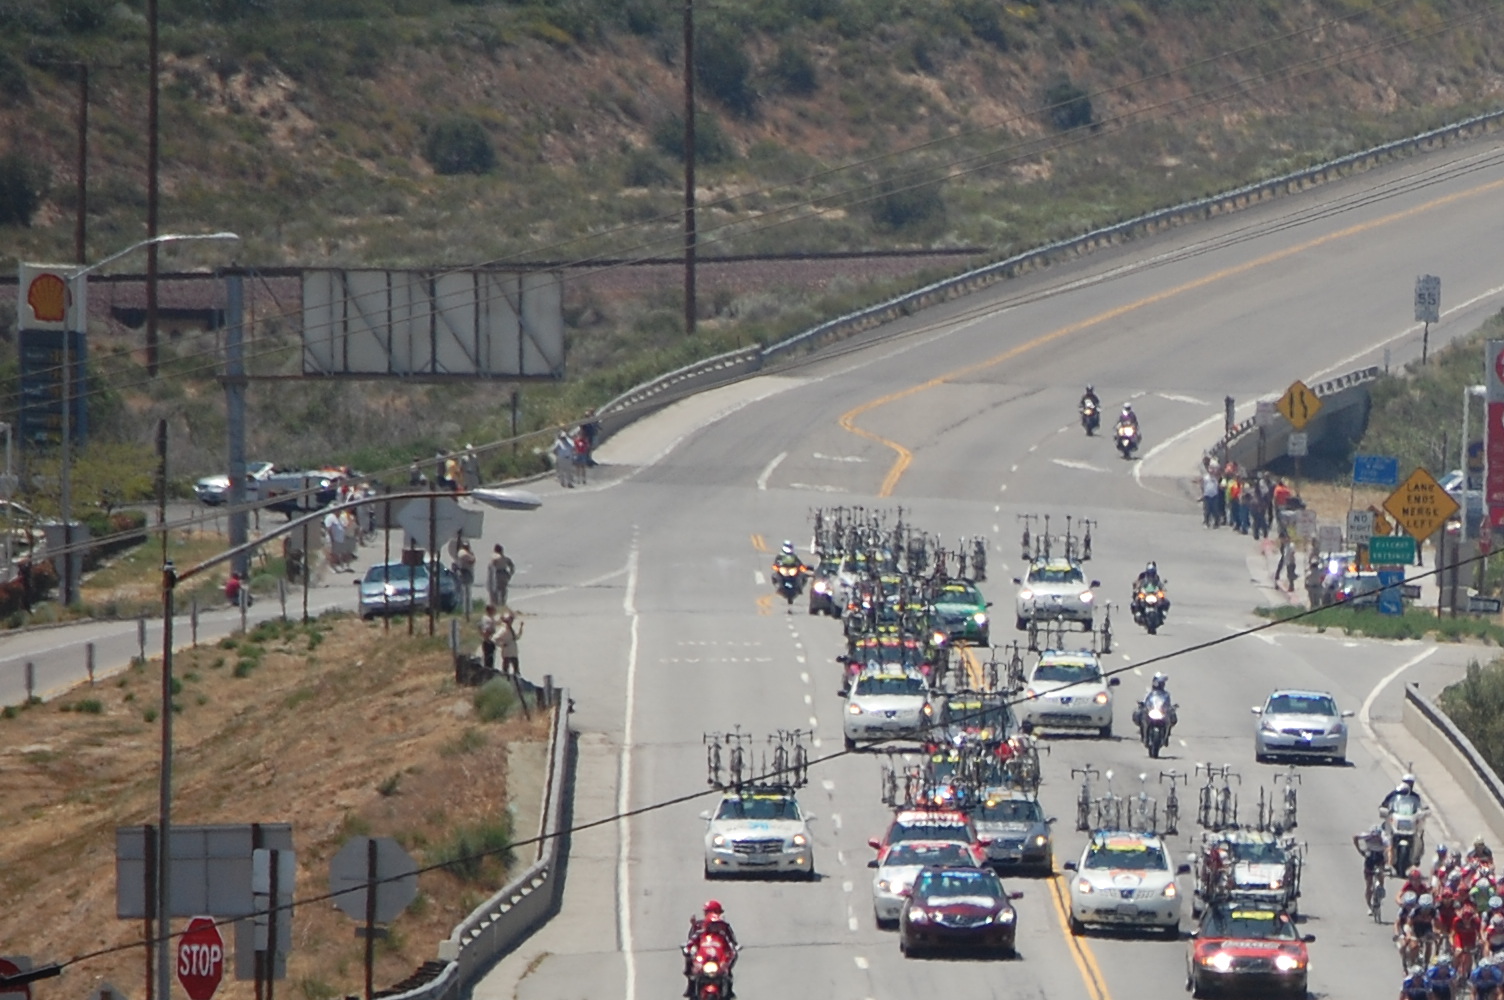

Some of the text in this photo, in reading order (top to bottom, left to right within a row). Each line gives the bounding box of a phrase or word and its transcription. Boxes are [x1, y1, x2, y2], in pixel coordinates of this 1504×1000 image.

[1418, 293, 1436, 305] 55
[1407, 484, 1435, 492] LANE
[1407, 495, 1435, 504] ENDS
[1402, 507, 1439, 517] MERGE
[1406, 519, 1433, 528] LEFT
[180, 944, 222, 977] STOP
